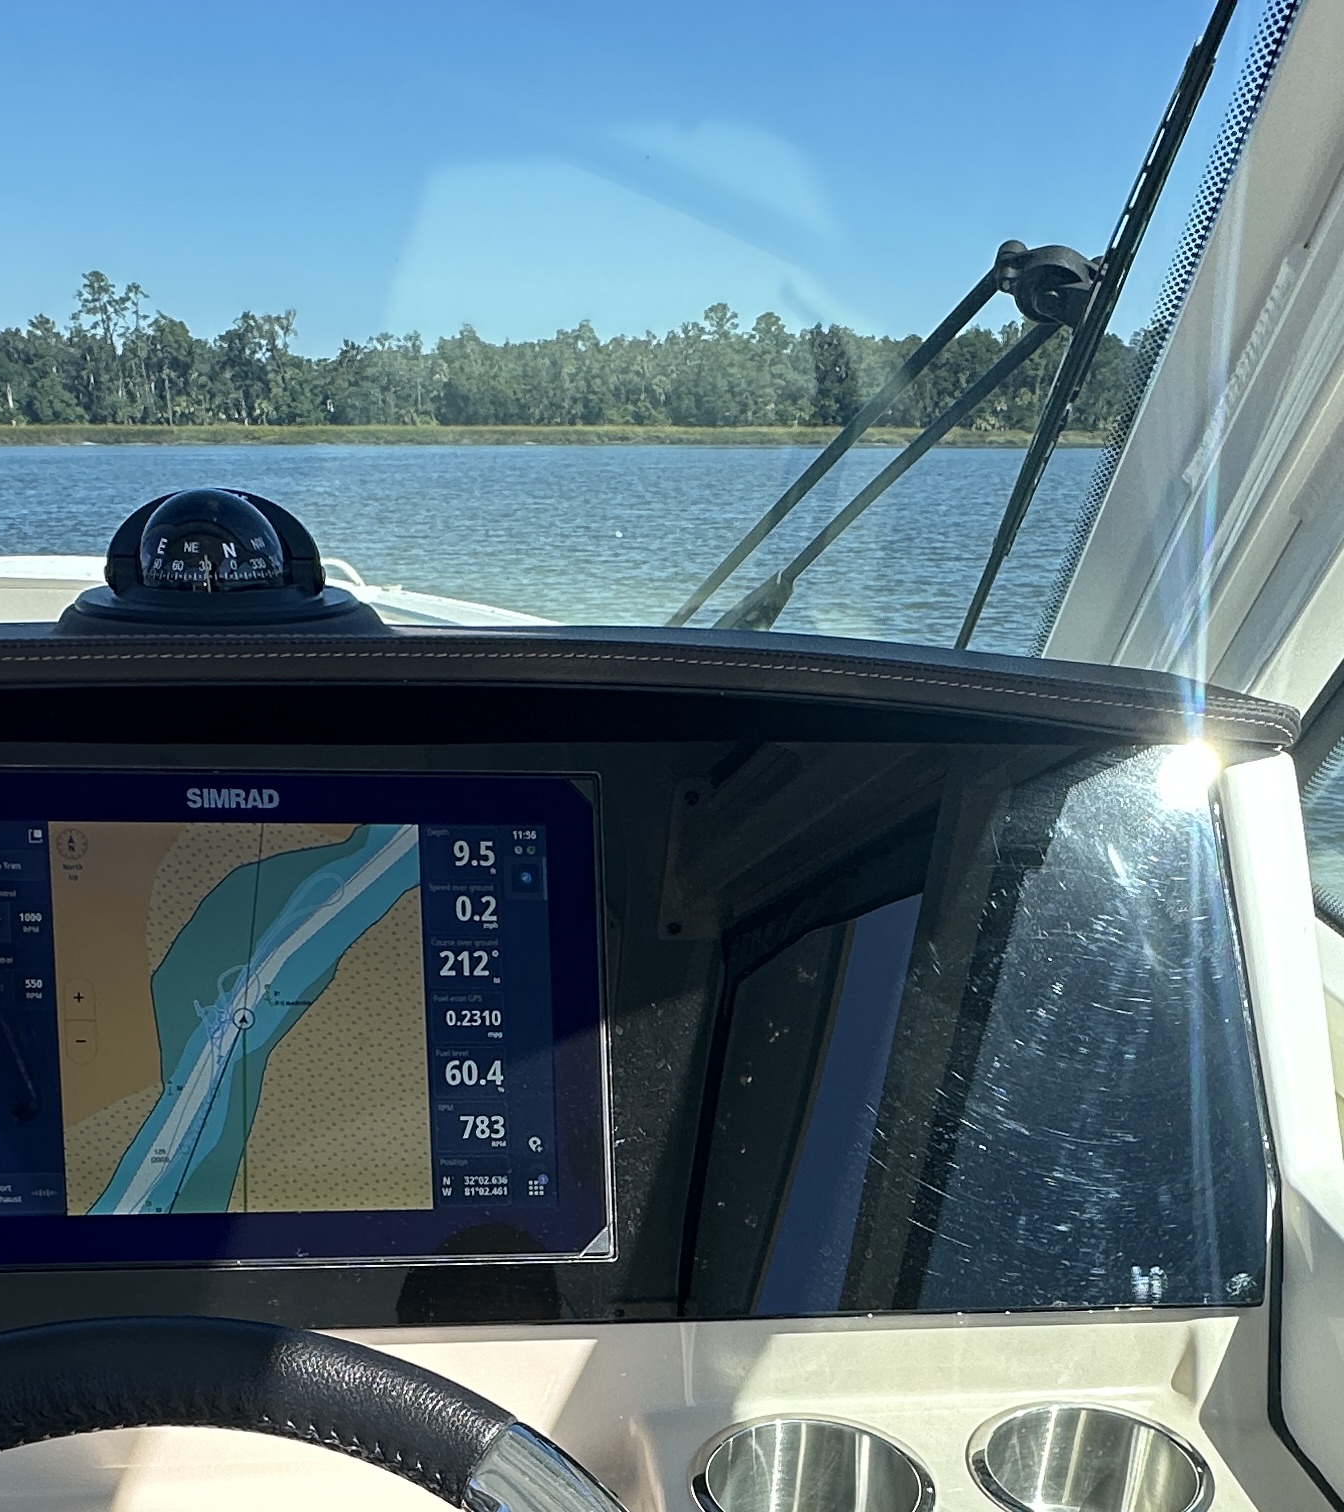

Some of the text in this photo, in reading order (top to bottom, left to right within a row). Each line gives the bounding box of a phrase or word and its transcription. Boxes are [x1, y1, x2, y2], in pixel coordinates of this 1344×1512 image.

[157, 538, 168, 555] E
[184, 541, 199, 553] NE
[222, 542, 237, 558] N
[172, 559, 184, 571] 60
[199, 560, 212, 571] 30
[230, 559, 238, 570] 0
[250, 557, 266, 569] 330
[186, 787, 280, 809] SIMRAD
[453, 840, 495, 866] 9.5
[4, 861, 21, 870] Trim
[456, 895, 497, 921] 0.2
[25, 979, 43, 988] 550
[445, 1010, 501, 1026] 0.2310
[445, 1060, 504, 1086] 60.4
[459, 1115, 505, 1139] 783
[442, 1176, 451, 1185] N
[442, 1187, 452, 1196] W
